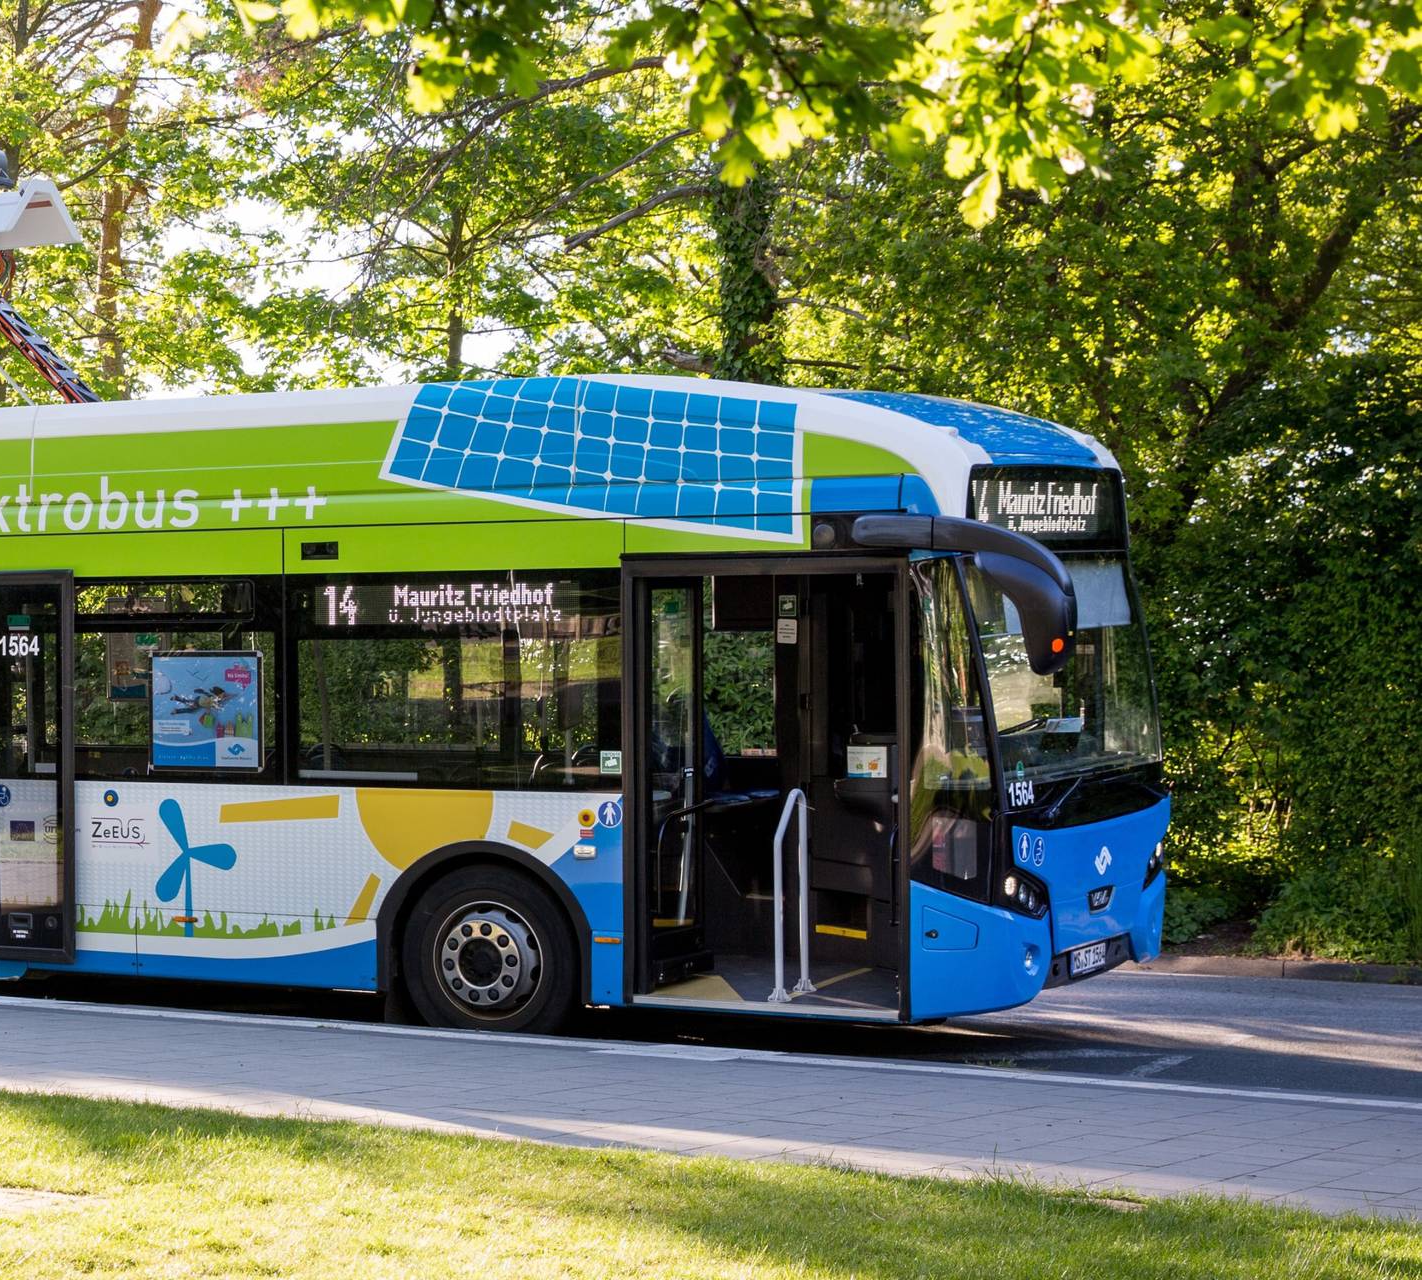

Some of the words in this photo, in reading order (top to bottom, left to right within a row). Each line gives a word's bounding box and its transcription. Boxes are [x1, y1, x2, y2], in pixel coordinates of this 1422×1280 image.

[997, 480, 1046, 515] Mauritz
[1046, 481, 1099, 515] Friedhof
[323, 585, 358, 625] 14
[394, 584, 465, 606] Mauritz
[470, 582, 554, 606] Friedhof
[1008, 780, 1034, 807] 1564
[91, 819, 141, 839] ZeEUS
